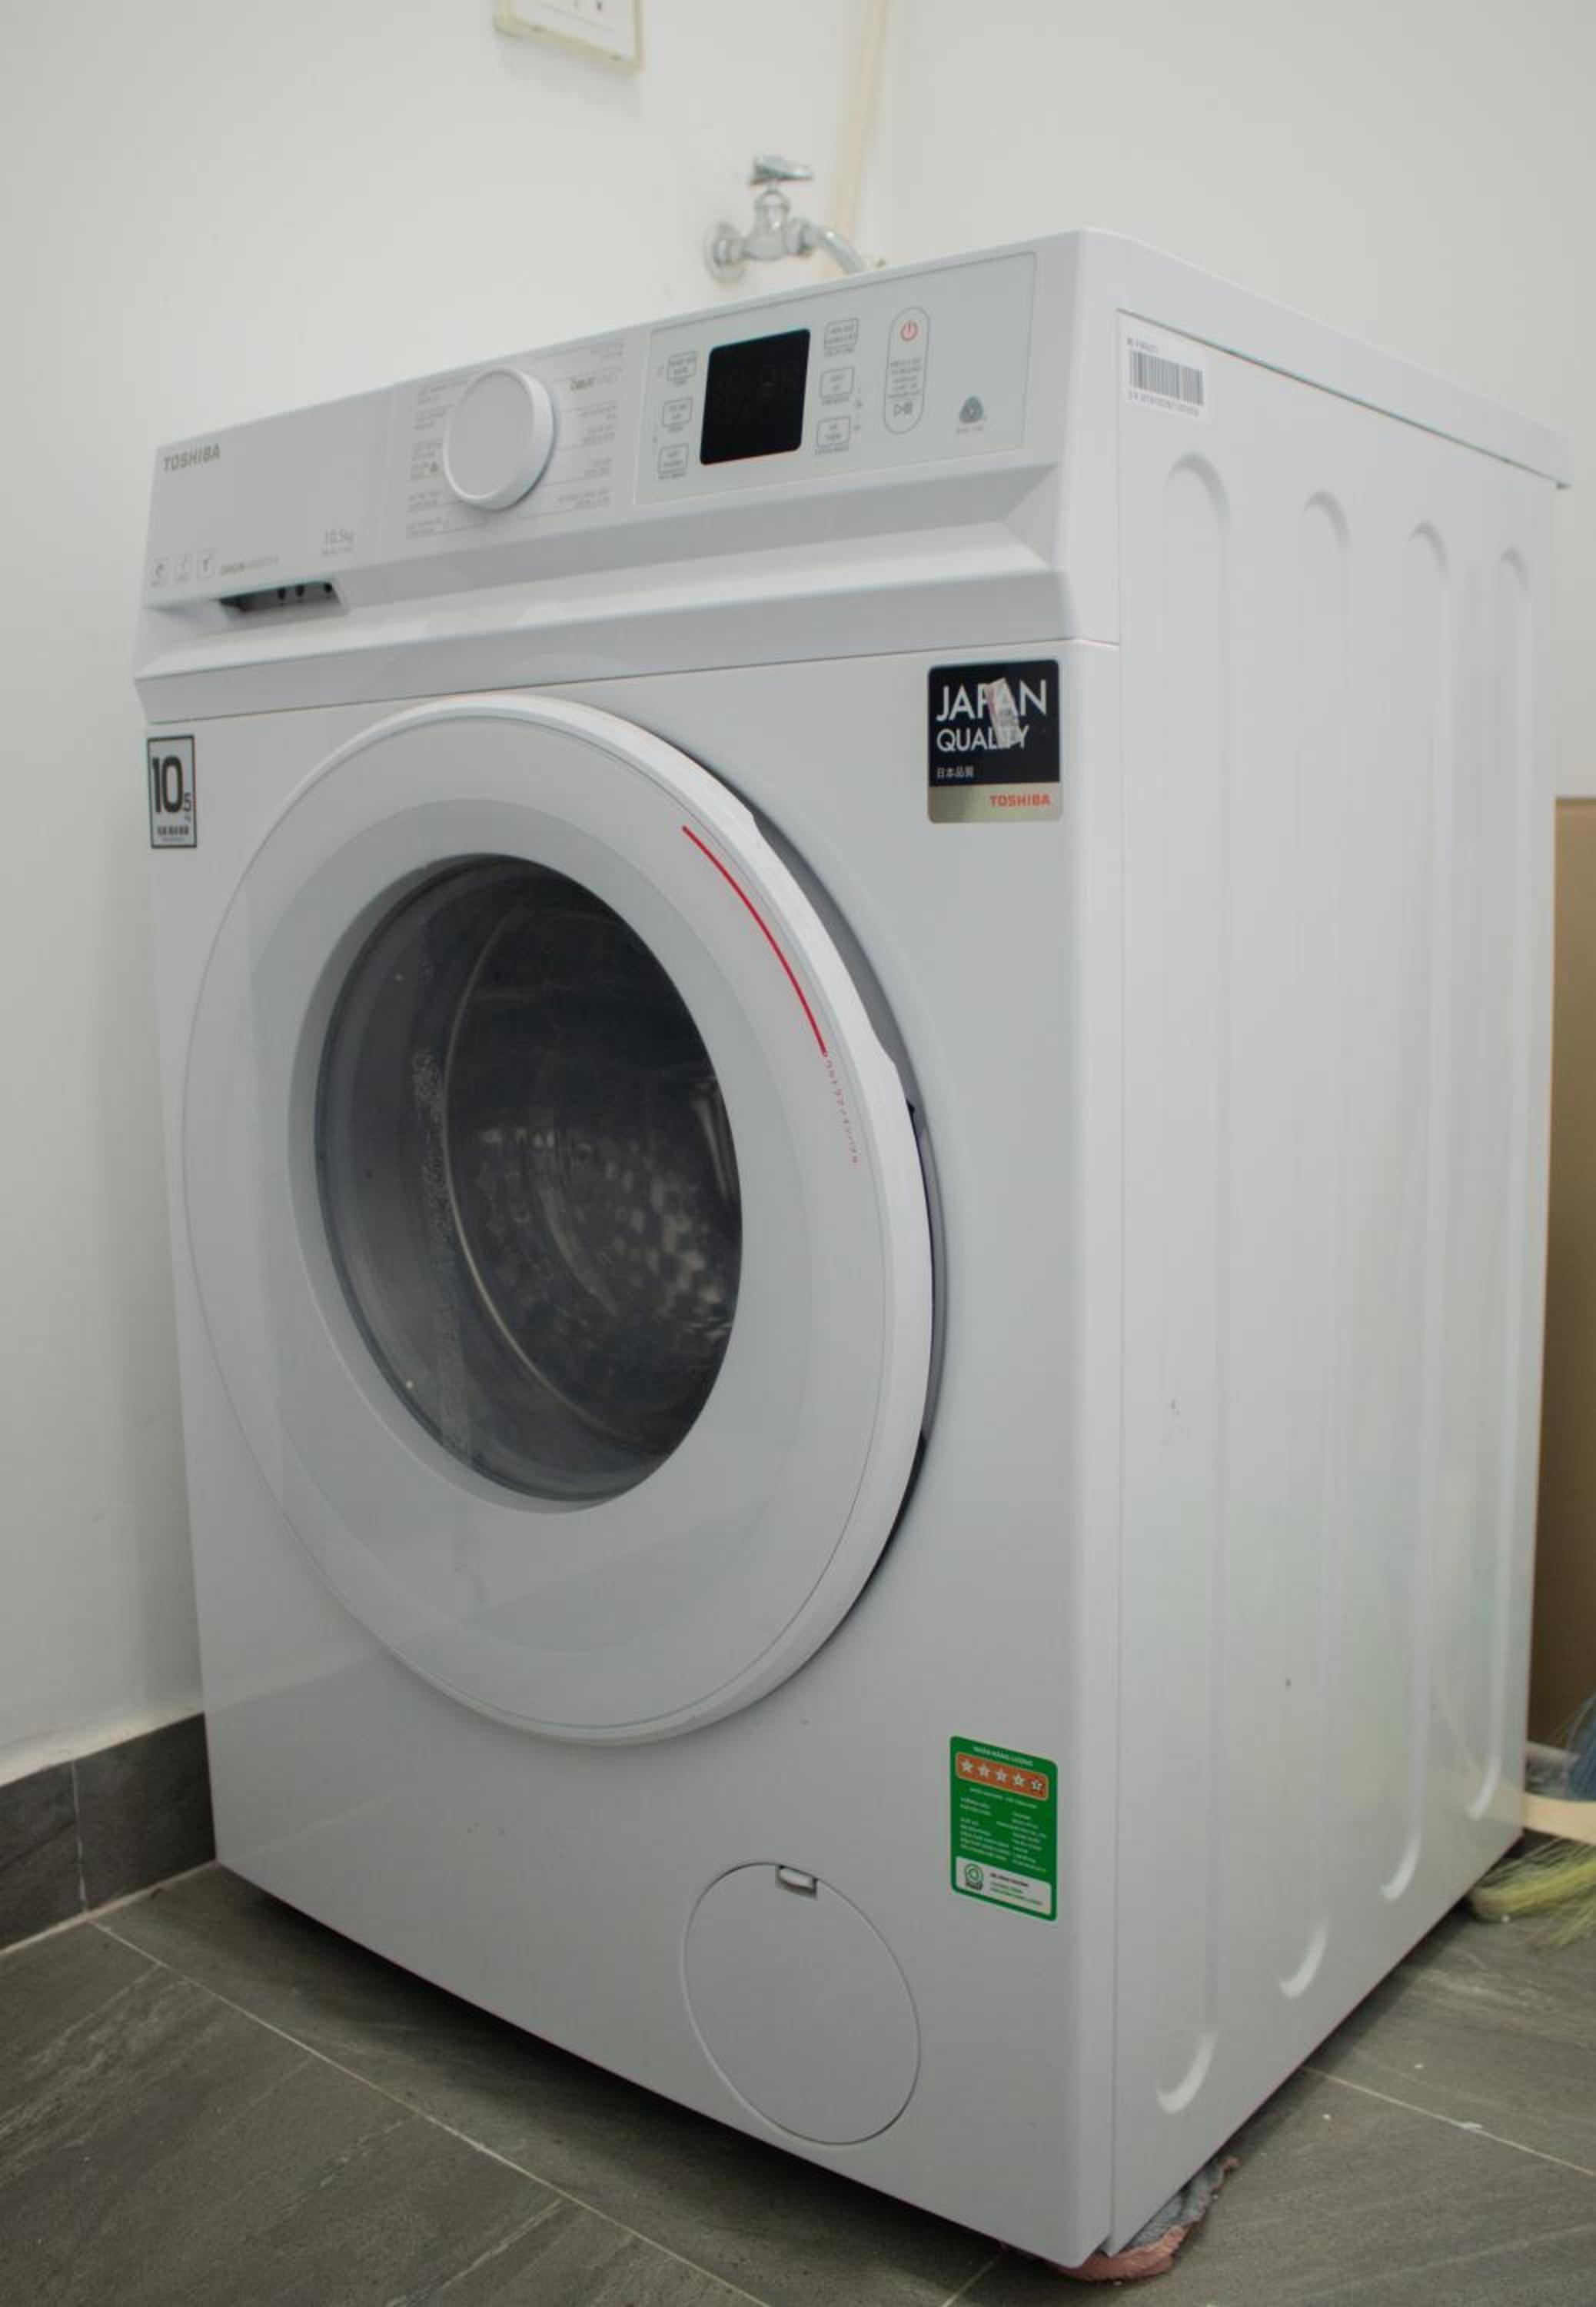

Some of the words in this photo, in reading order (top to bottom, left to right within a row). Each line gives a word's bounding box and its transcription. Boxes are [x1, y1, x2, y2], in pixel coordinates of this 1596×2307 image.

[164, 443, 221, 472] TOSHIBA
[936, 679, 1047, 722] JAPN
[936, 724, 1029, 752] QUALY
[989, 793, 1052, 807] TOSHIBA
